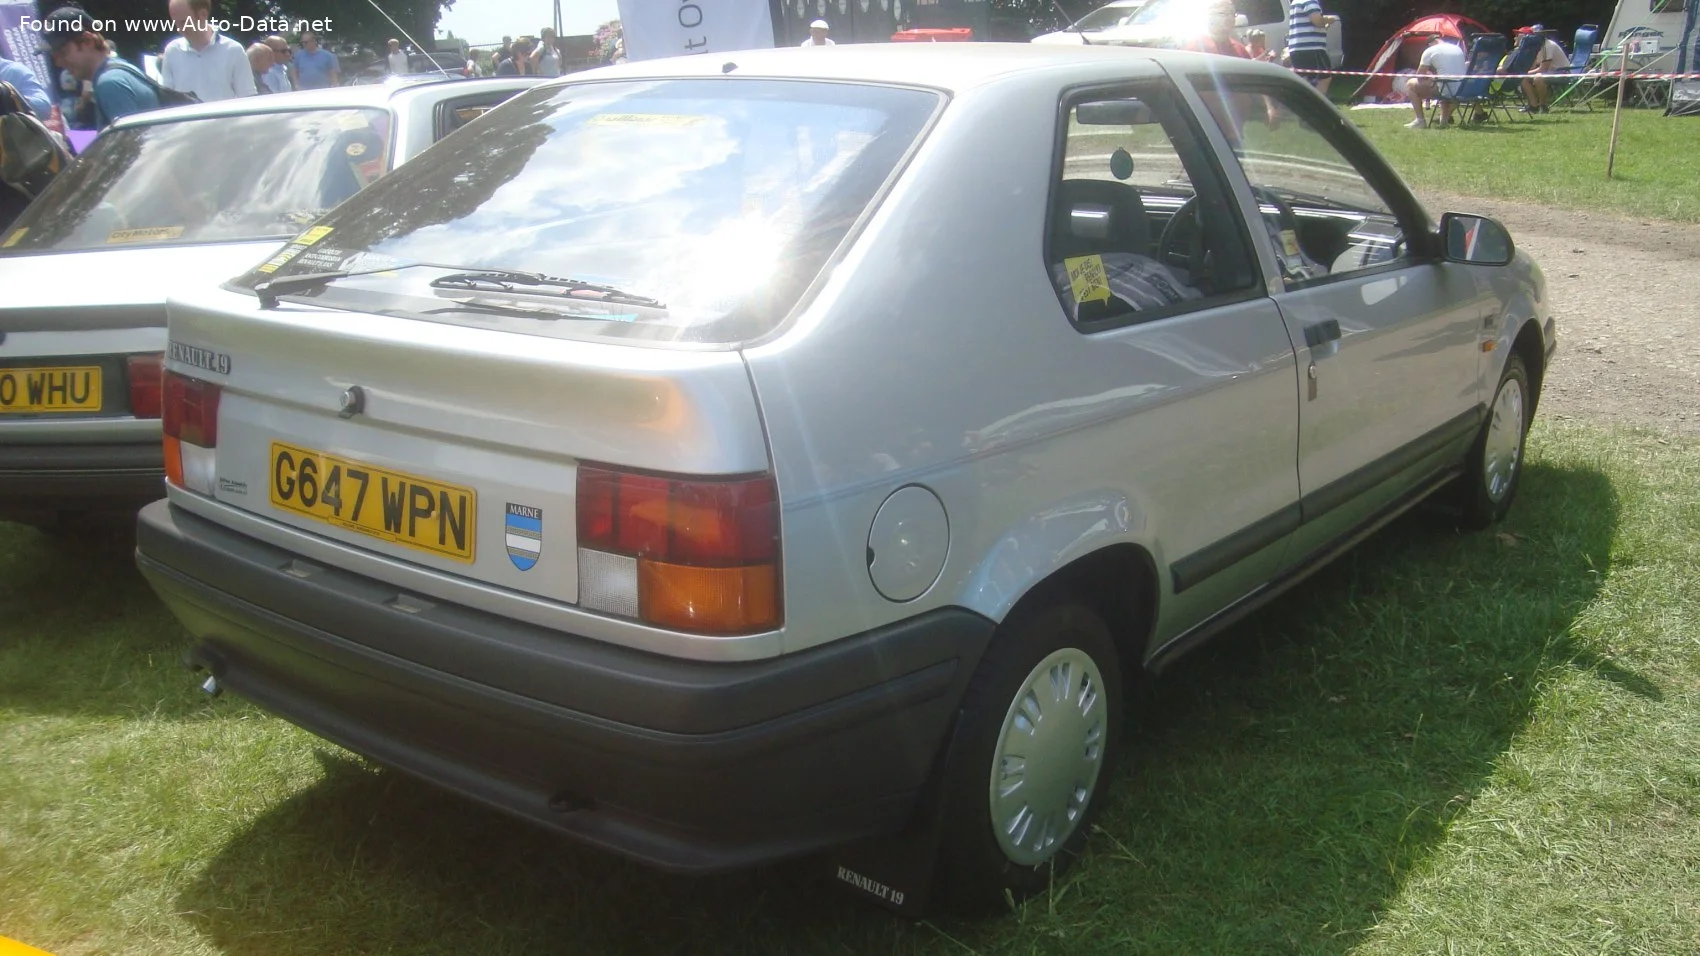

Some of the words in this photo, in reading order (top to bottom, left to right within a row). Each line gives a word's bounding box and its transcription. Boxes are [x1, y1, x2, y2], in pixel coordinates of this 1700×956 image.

[167, 341, 213, 370] RENAULT
[214, 353, 231, 375] 19
[27, 371, 91, 406] WHU
[275, 450, 370, 522] G647
[381, 476, 467, 551] WPN
[509, 504, 539, 519] MARNE
[837, 866, 889, 899] RENAULT
[890, 889, 904, 905] 19
